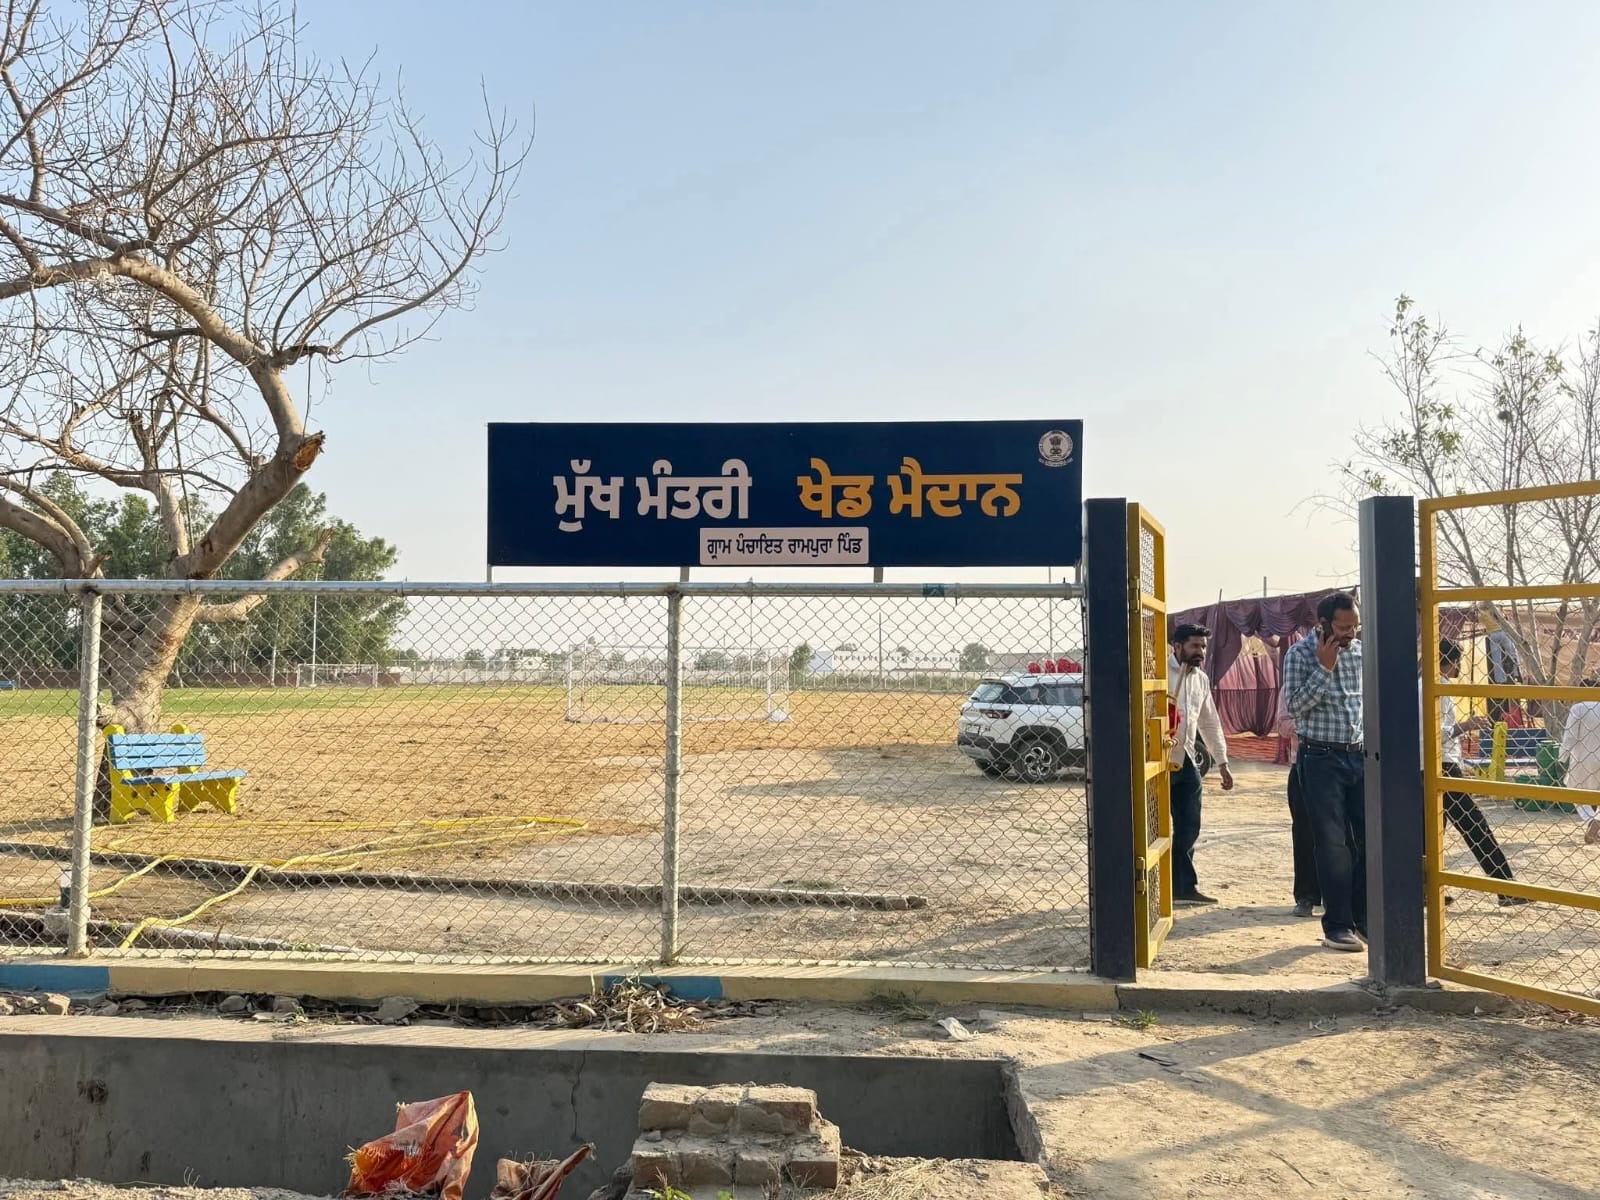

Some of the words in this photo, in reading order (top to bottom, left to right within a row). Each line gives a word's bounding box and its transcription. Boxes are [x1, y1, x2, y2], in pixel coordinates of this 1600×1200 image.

[553, 459, 624, 532] ਮੁੱਖ
[635, 458, 753, 520] ਮੰਤਰੀ
[797, 457, 874, 518] ਖੇਡ
[887, 456, 1023, 518] ਮੈਦਾਨ
[707, 538, 732, 559] ਗ੍ਰਾਮ
[736, 532, 784, 554] ਪੰਚਾਇਤ
[788, 538, 833, 557] ਰਾਮਪੁਰਾ
[837, 532, 863, 554] ਪਿੰਡ
